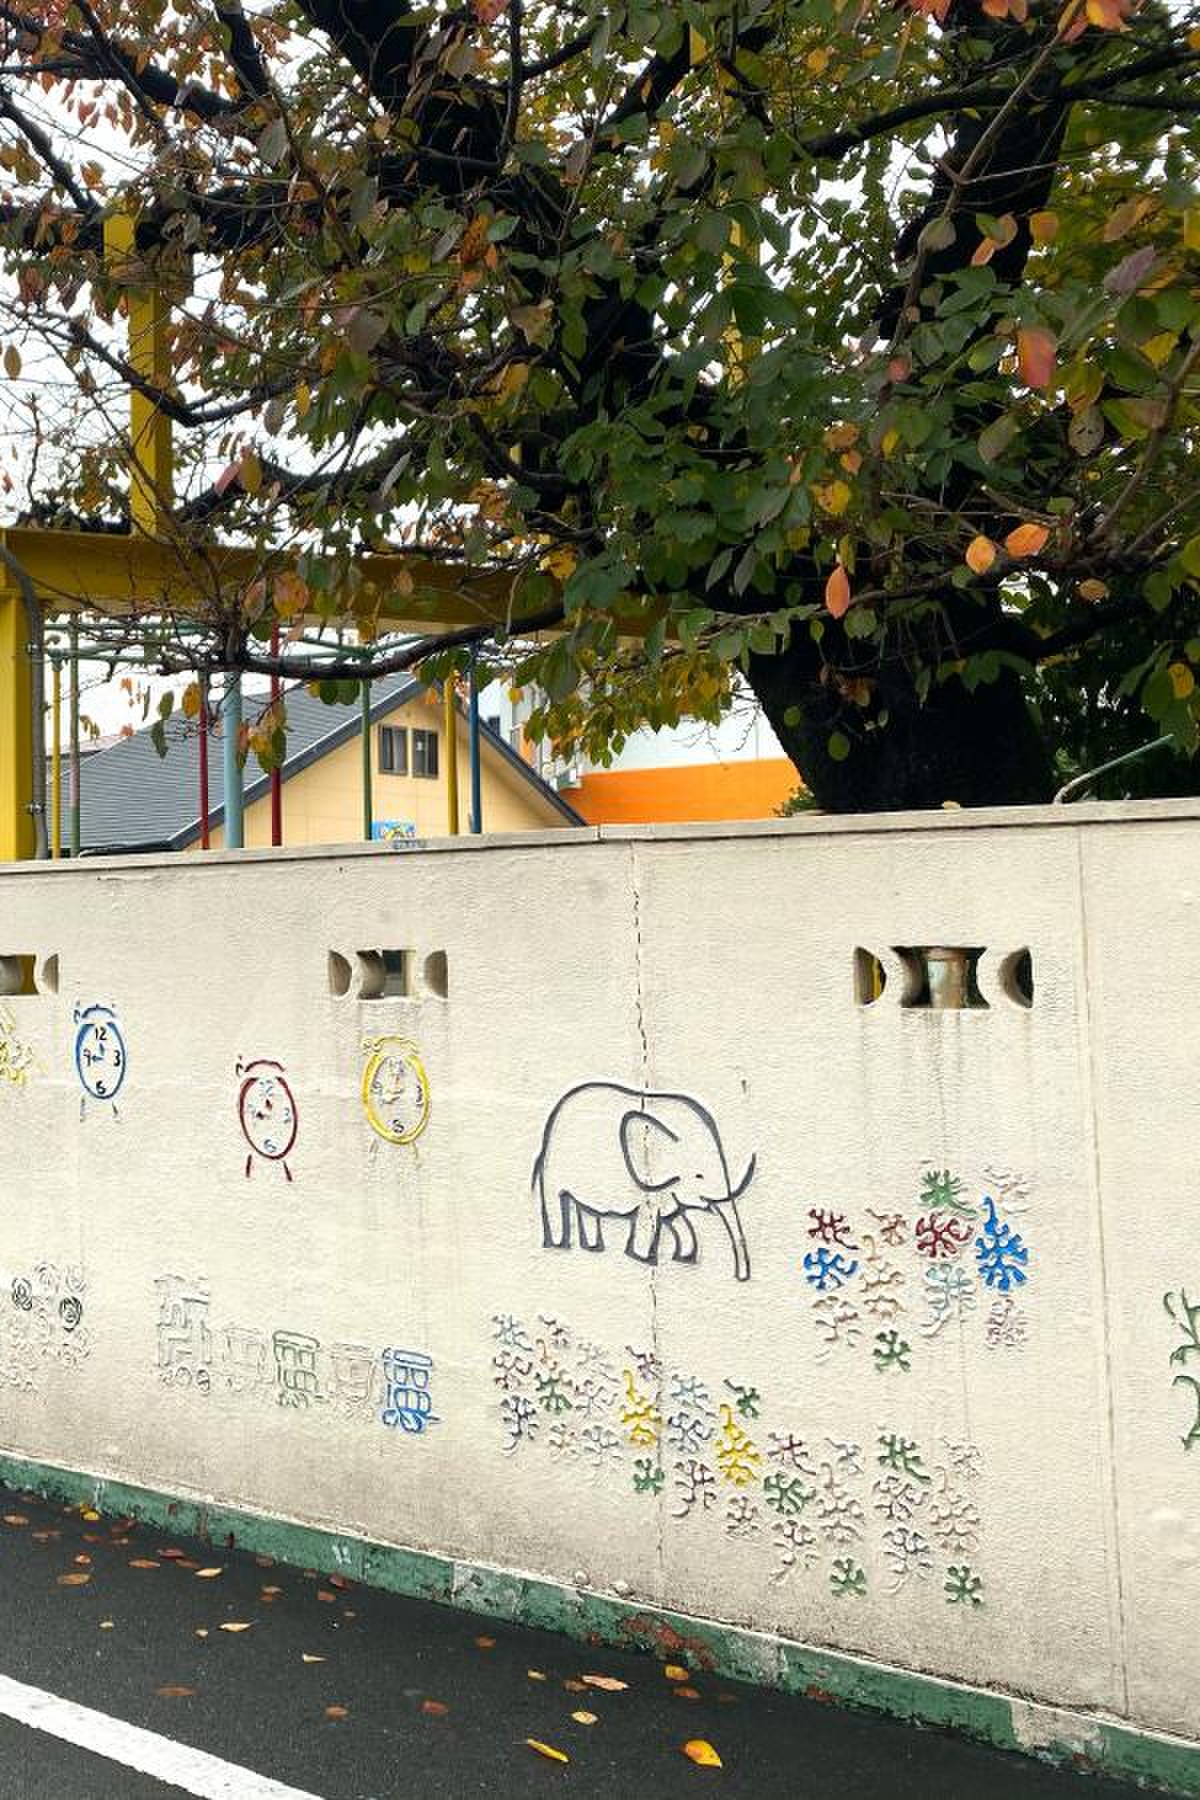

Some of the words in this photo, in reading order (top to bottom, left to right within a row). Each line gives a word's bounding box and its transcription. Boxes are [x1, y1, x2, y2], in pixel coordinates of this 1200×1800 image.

[95, 1025, 108, 1041] 12
[82, 1048, 92, 1067] 9
[113, 1049, 121, 1067] 3
[95, 1080, 107, 1095] 6
[392, 1119, 405, 1134] 6
[263, 1138, 277, 1153] 6
